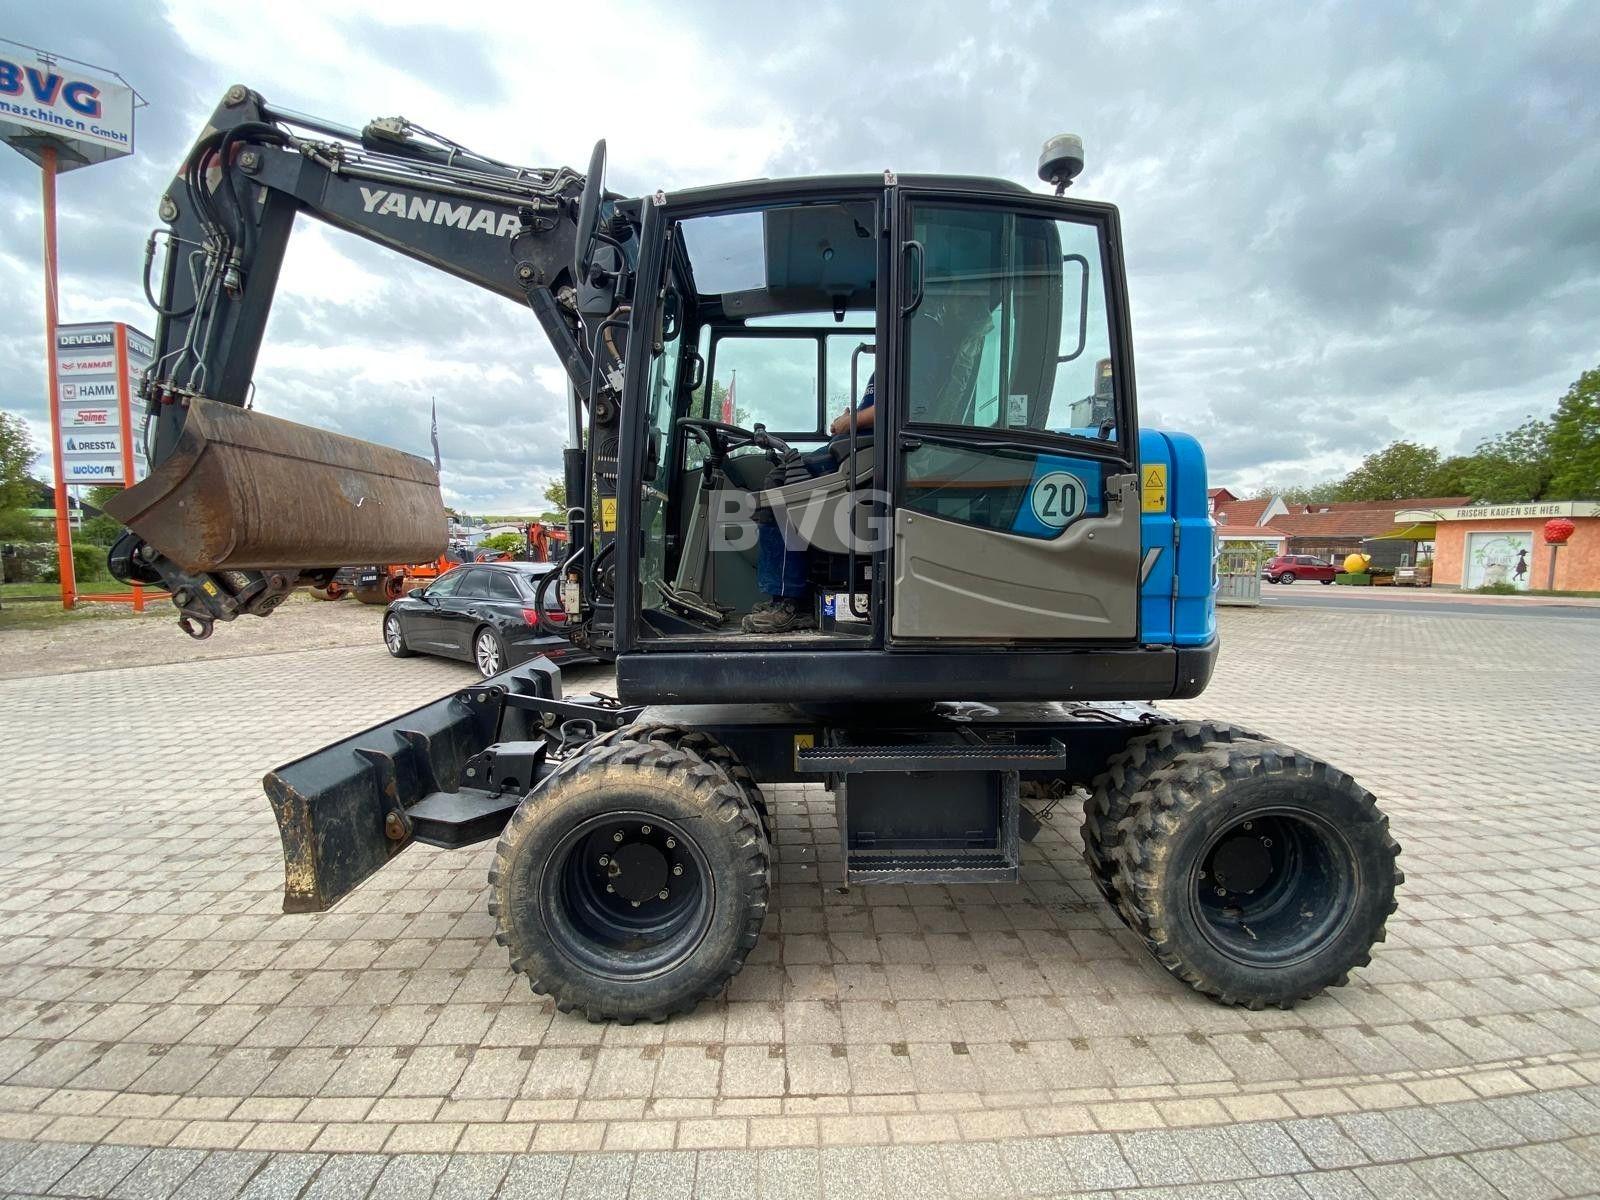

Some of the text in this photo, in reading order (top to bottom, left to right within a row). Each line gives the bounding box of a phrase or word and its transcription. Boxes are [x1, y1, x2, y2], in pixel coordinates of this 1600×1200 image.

[0, 58, 101, 119] BVG
[90, 125, 128, 142] GmbH
[360, 187, 523, 238] YANMAR
[60, 333, 111, 345] DEVELON
[76, 361, 113, 369] YANMAR
[79, 385, 115, 396] HAMM
[79, 441, 116, 450] DRESSTA
[1042, 483, 1076, 517] 20
[1457, 509, 1488, 518] FRISCHE
[1490, 507, 1521, 517] KAUFEN
[1523, 506, 1537, 515] SIE
